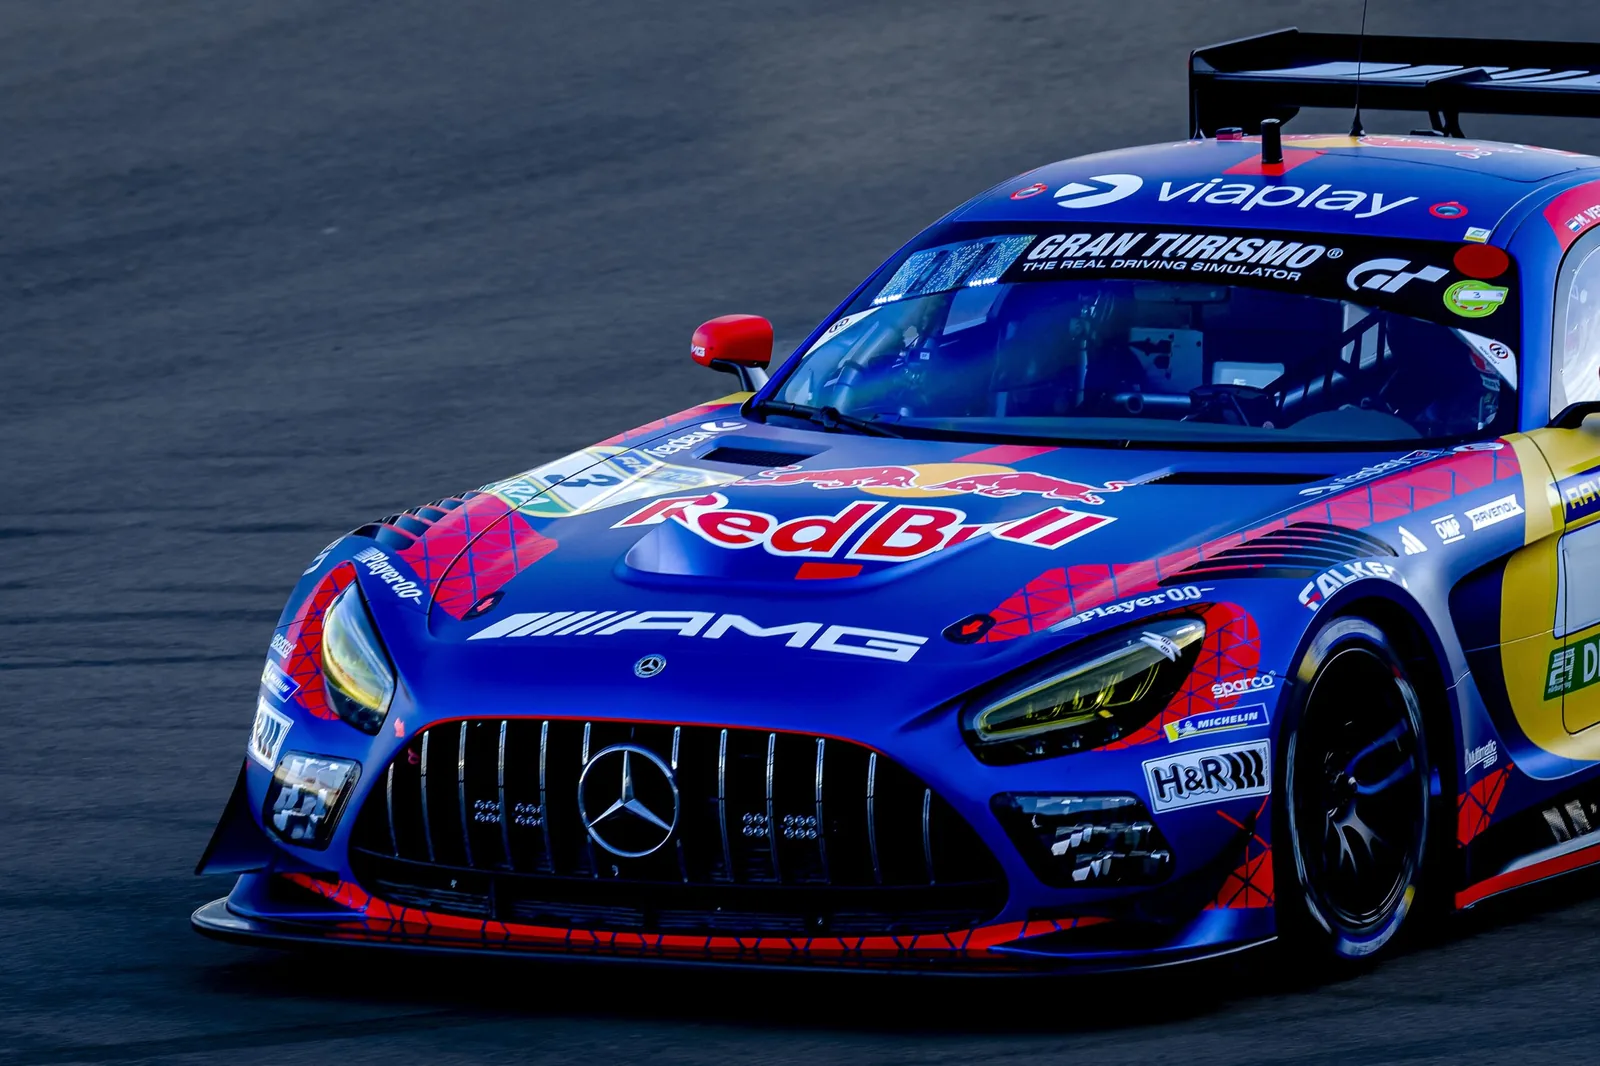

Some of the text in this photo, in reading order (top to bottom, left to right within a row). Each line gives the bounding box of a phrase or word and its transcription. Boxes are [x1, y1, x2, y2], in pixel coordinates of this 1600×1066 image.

[1158, 177, 1418, 219] viaplay
[1027, 232, 1147, 260] GRAN
[1022, 259, 1302, 282] THE REAL DRIVING SIMULATOR
[1472, 501, 1517, 524] RAVENOL
[1435, 518, 1460, 540] OMP
[596, 610, 929, 662] AMG
[1211, 674, 1274, 698] sparco
[1197, 711, 1258, 729] MICHELIN
[1151, 757, 1232, 802] H&R
